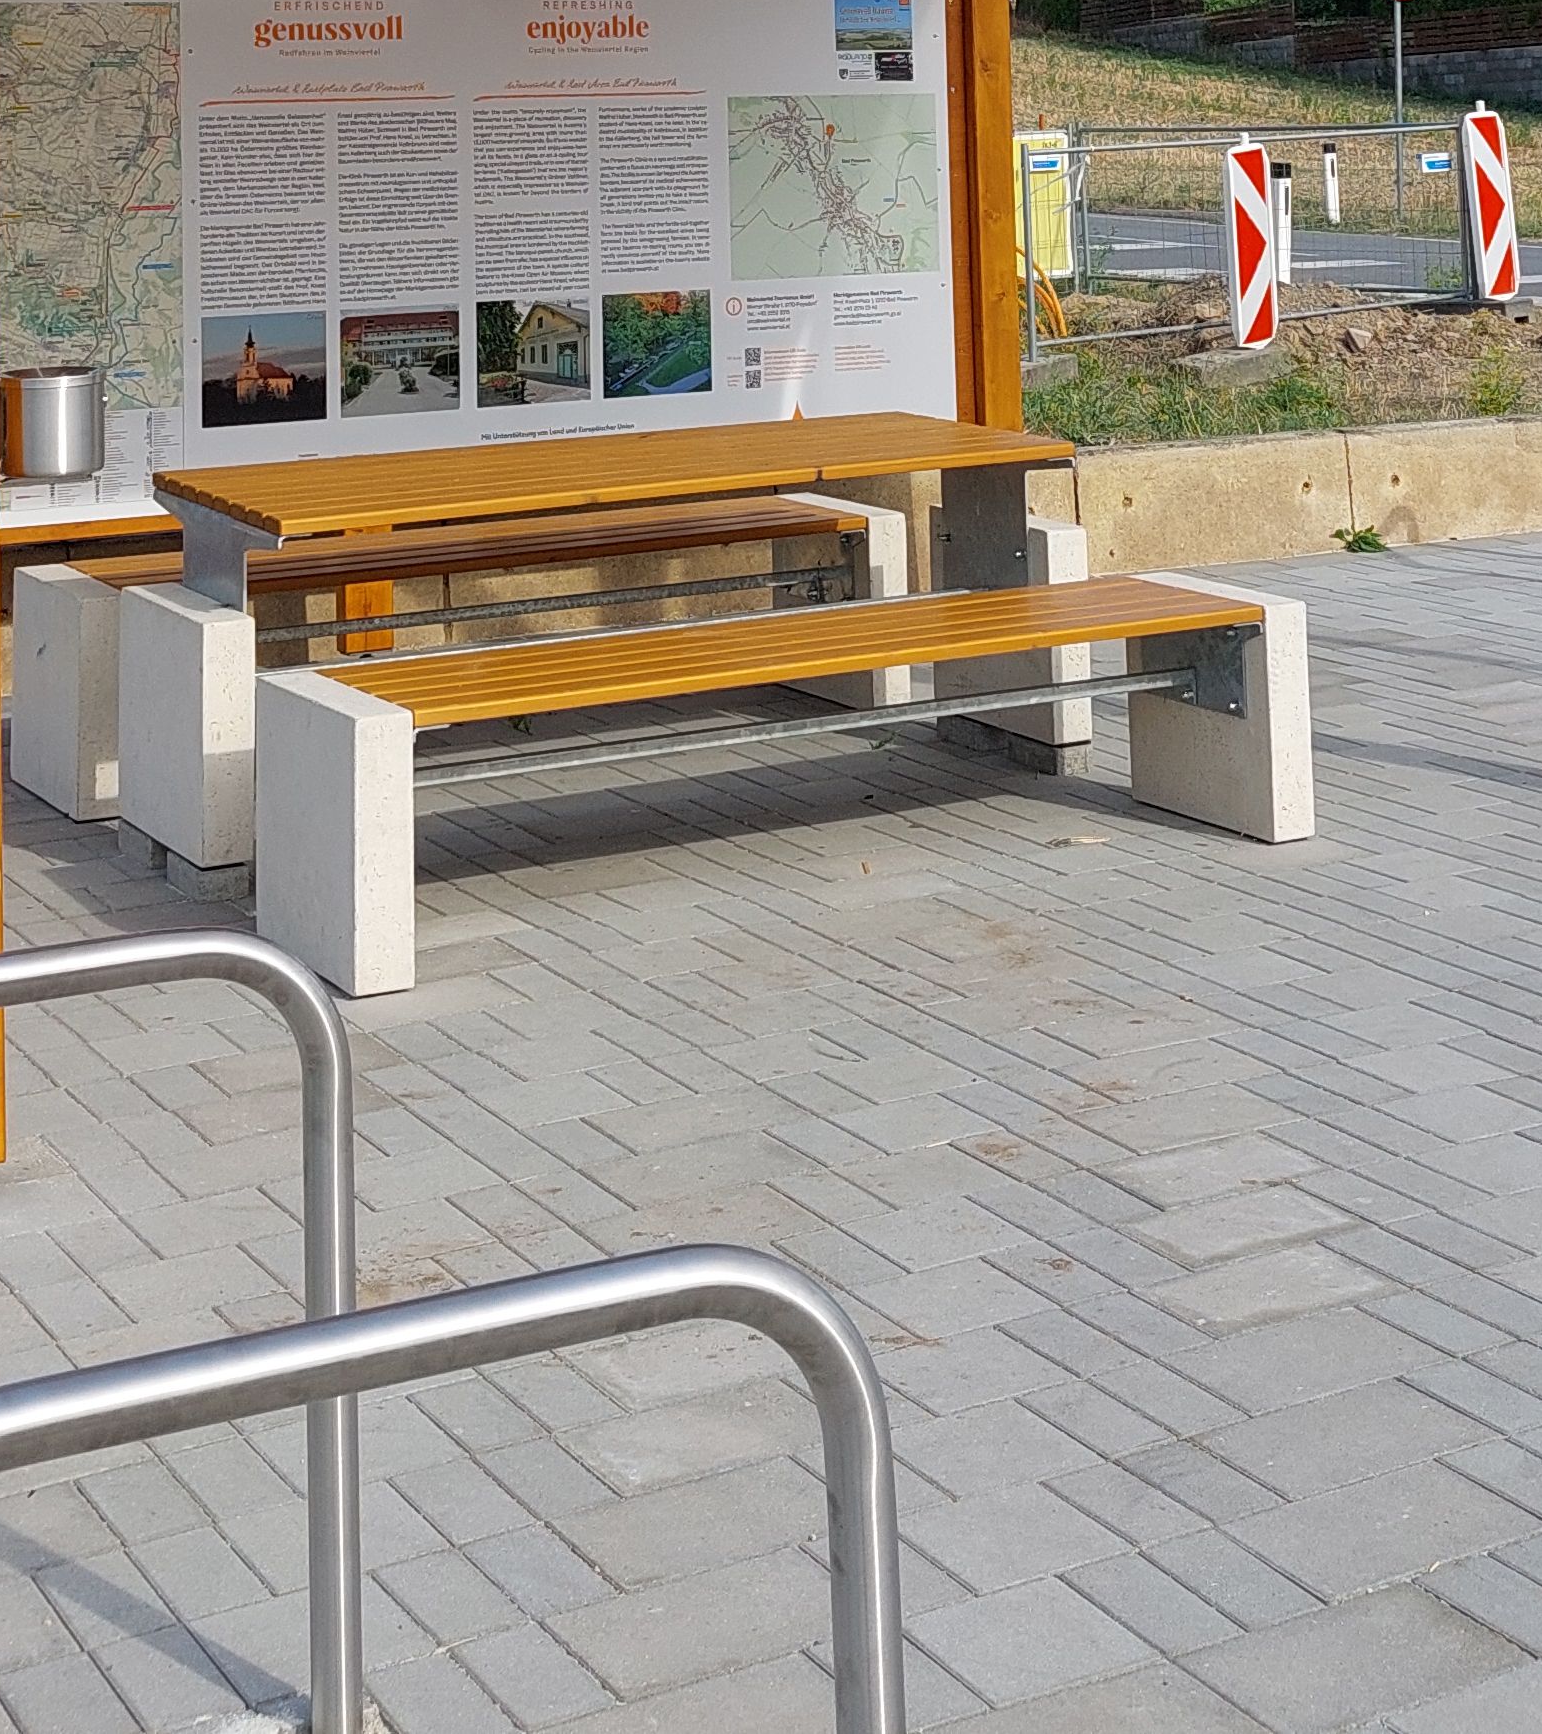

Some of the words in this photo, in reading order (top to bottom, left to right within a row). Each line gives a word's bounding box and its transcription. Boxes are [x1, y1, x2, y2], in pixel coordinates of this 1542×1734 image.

[274, 1, 384, 11] ERFRISCHEND
[543, 0, 633, 10] REFRESHING
[254, 14, 403, 48] genussvoll
[527, 14, 649, 44] enjoyable
[335, 48, 380, 56] Weinviertel
[625, 46, 649, 54] Region
[493, 431, 536, 440] Unterstützung
[549, 427, 565, 435] Land
